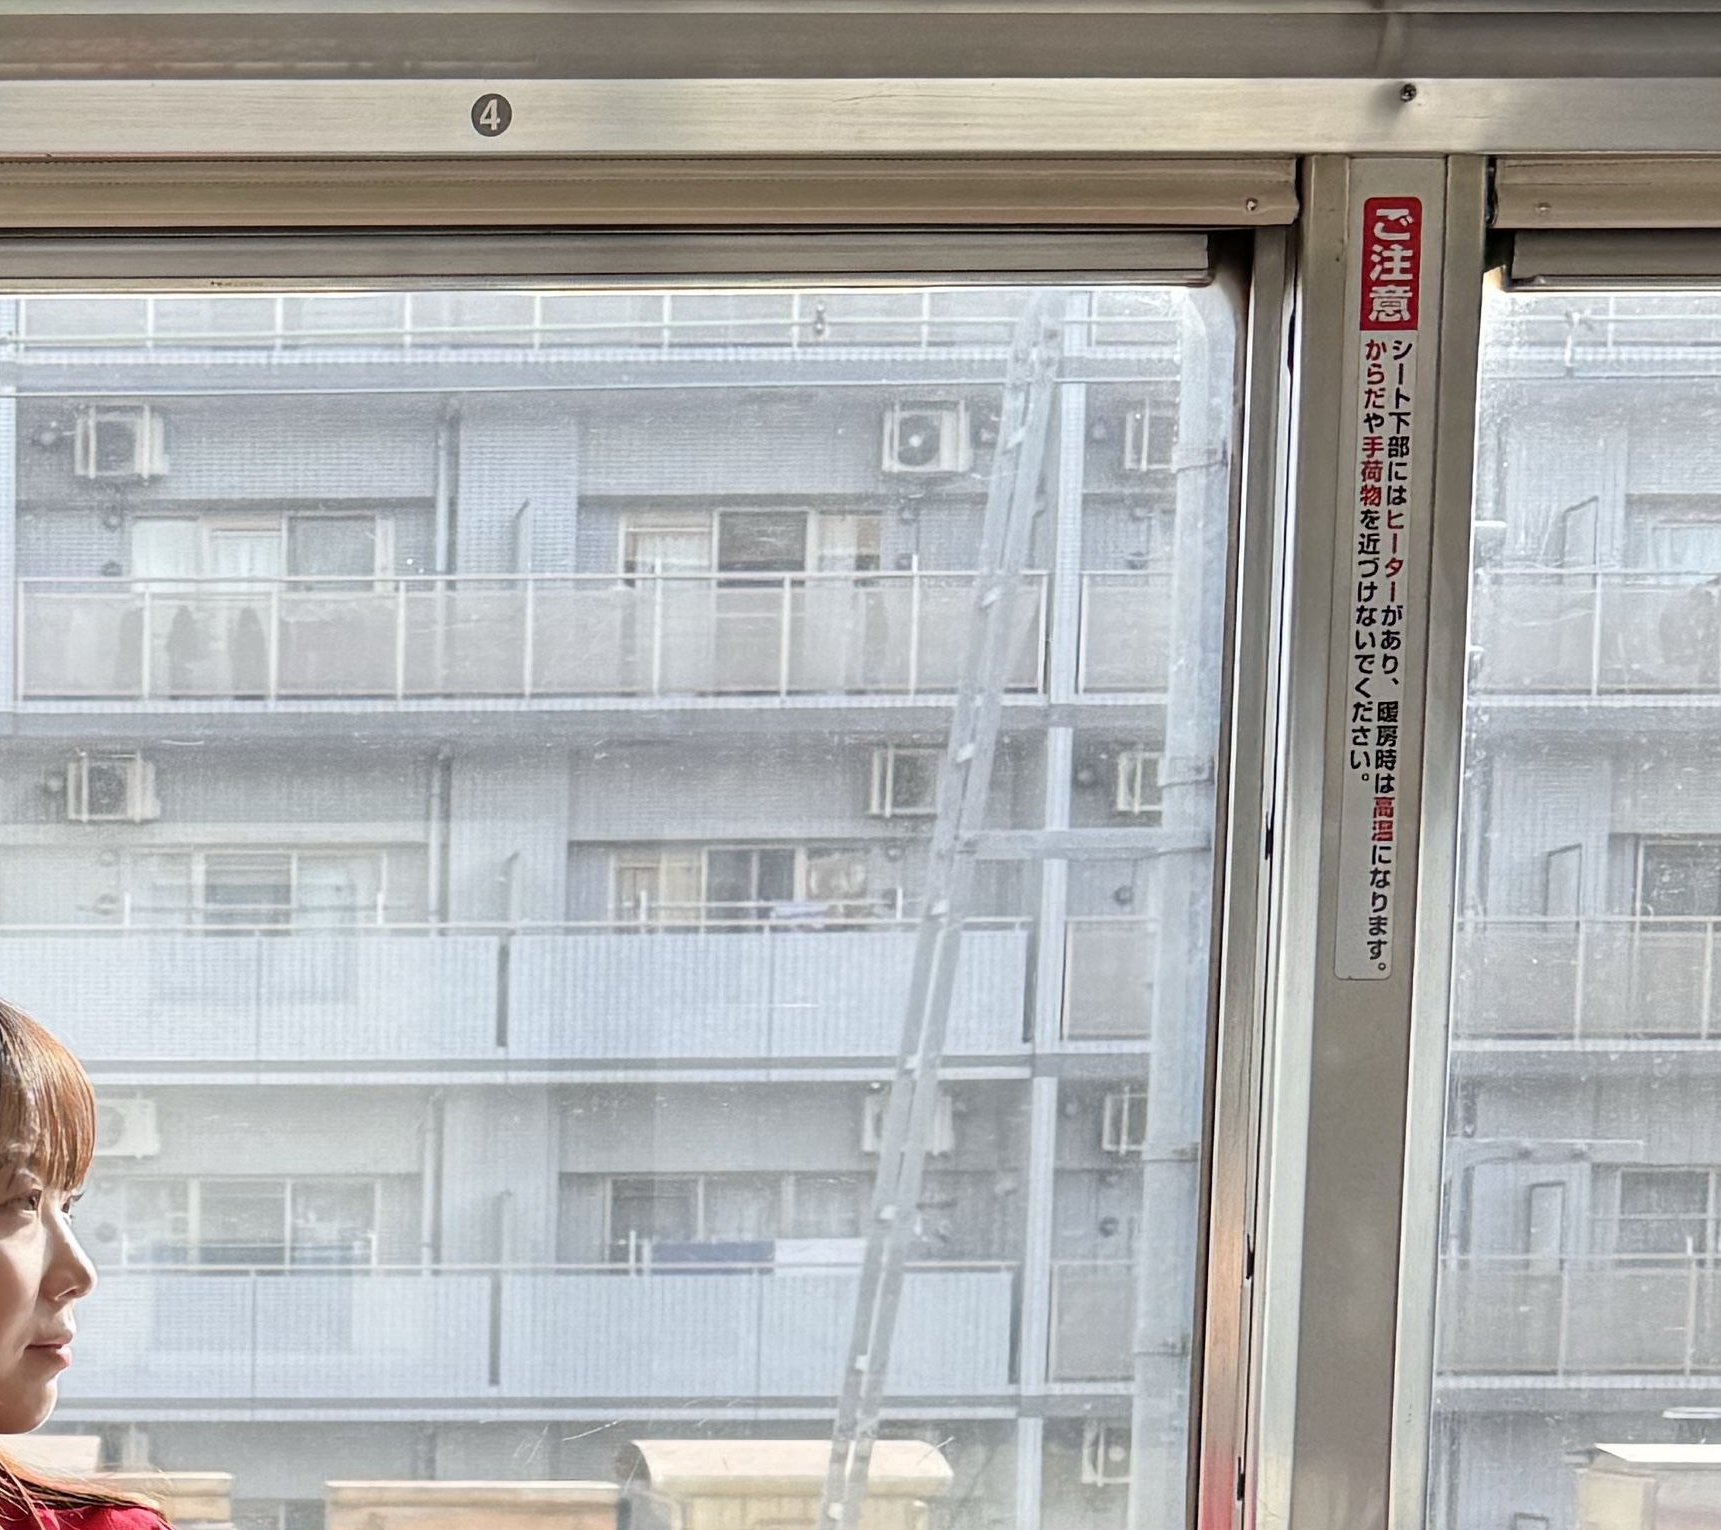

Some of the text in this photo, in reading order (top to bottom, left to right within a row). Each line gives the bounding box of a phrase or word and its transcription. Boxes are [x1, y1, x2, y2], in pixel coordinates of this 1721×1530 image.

[477, 97, 504, 133] 4
[1368, 207, 1415, 322] ご注意
